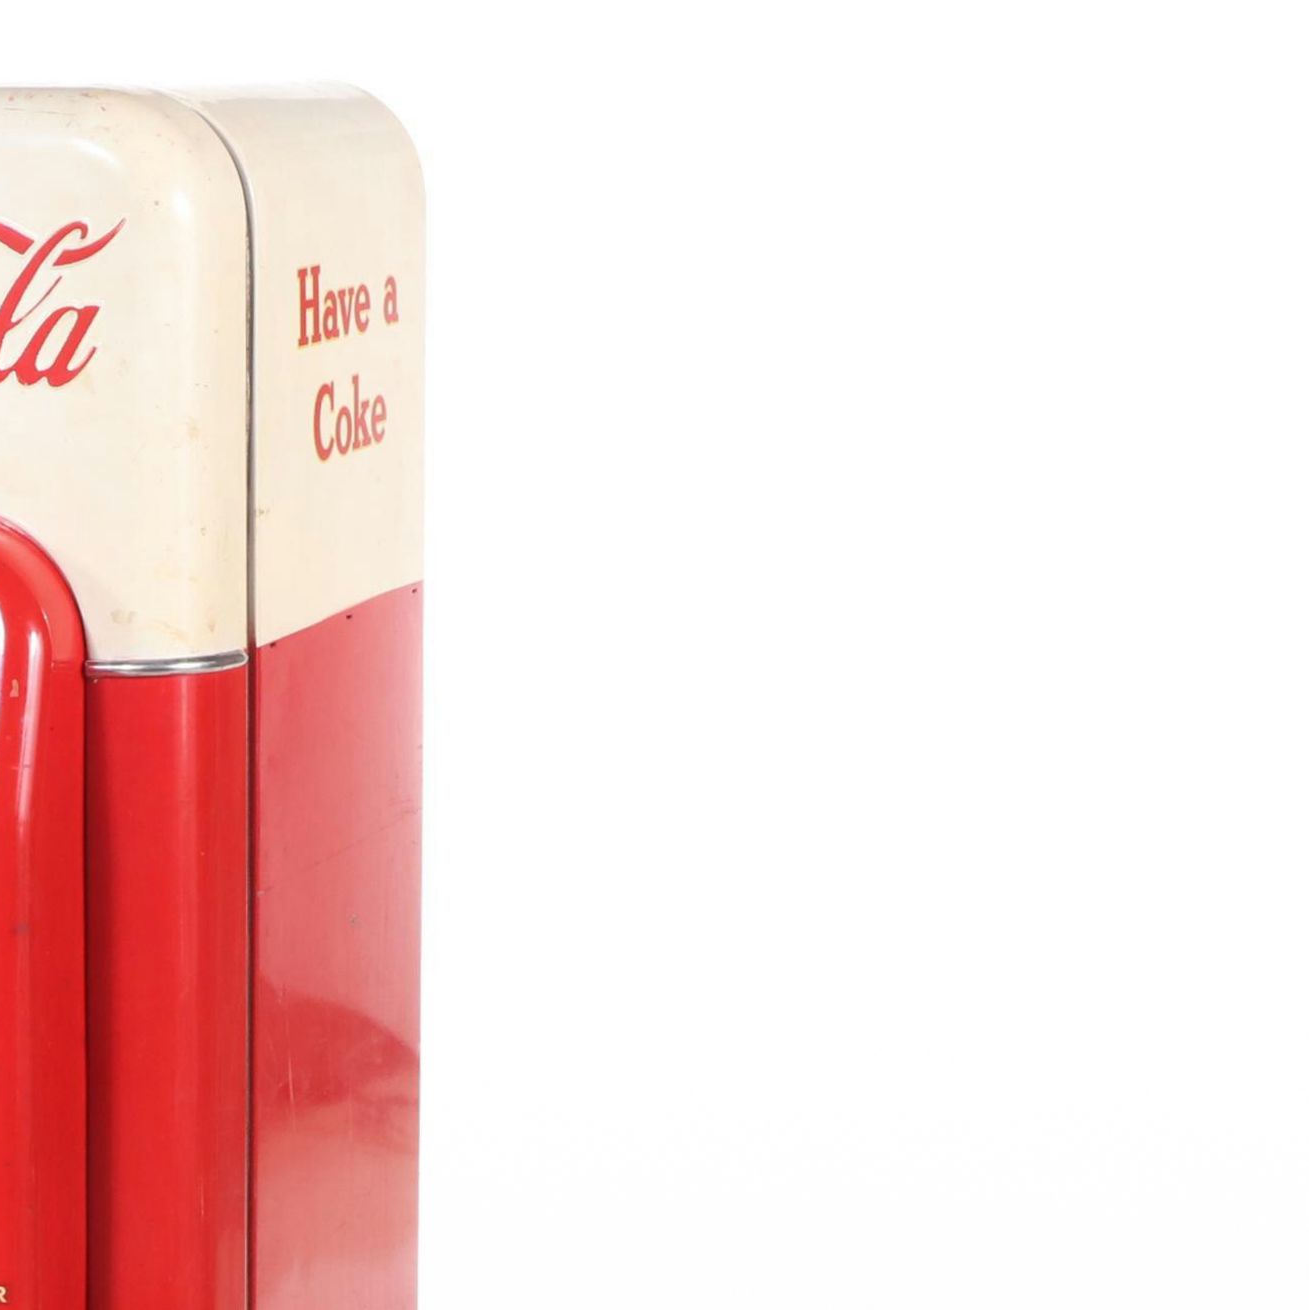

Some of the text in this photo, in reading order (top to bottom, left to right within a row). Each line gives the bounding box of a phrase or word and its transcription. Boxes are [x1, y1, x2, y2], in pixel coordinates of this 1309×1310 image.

[297, 265, 399, 347] Have a
[313, 374, 387, 462] Coke
